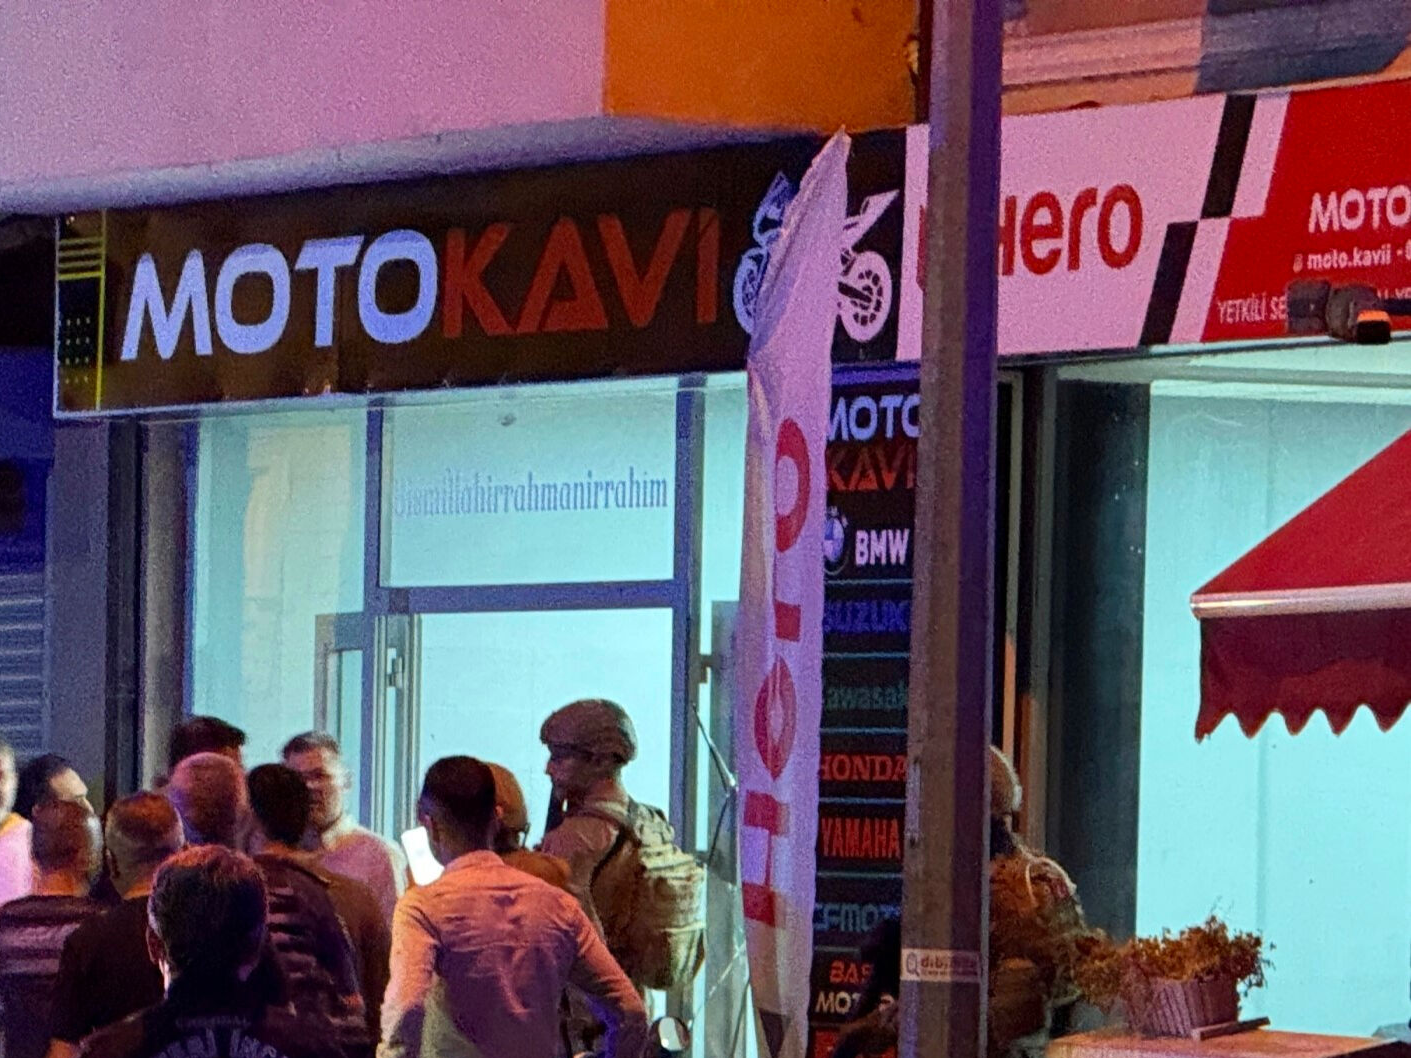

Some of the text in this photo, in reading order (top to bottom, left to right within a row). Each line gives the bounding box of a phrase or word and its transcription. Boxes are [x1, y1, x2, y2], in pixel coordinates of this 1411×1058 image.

[1308, 185, 1411, 234] MOTO
[854, 528, 910, 567] BMW
[821, 817, 901, 860] YAMAHA
